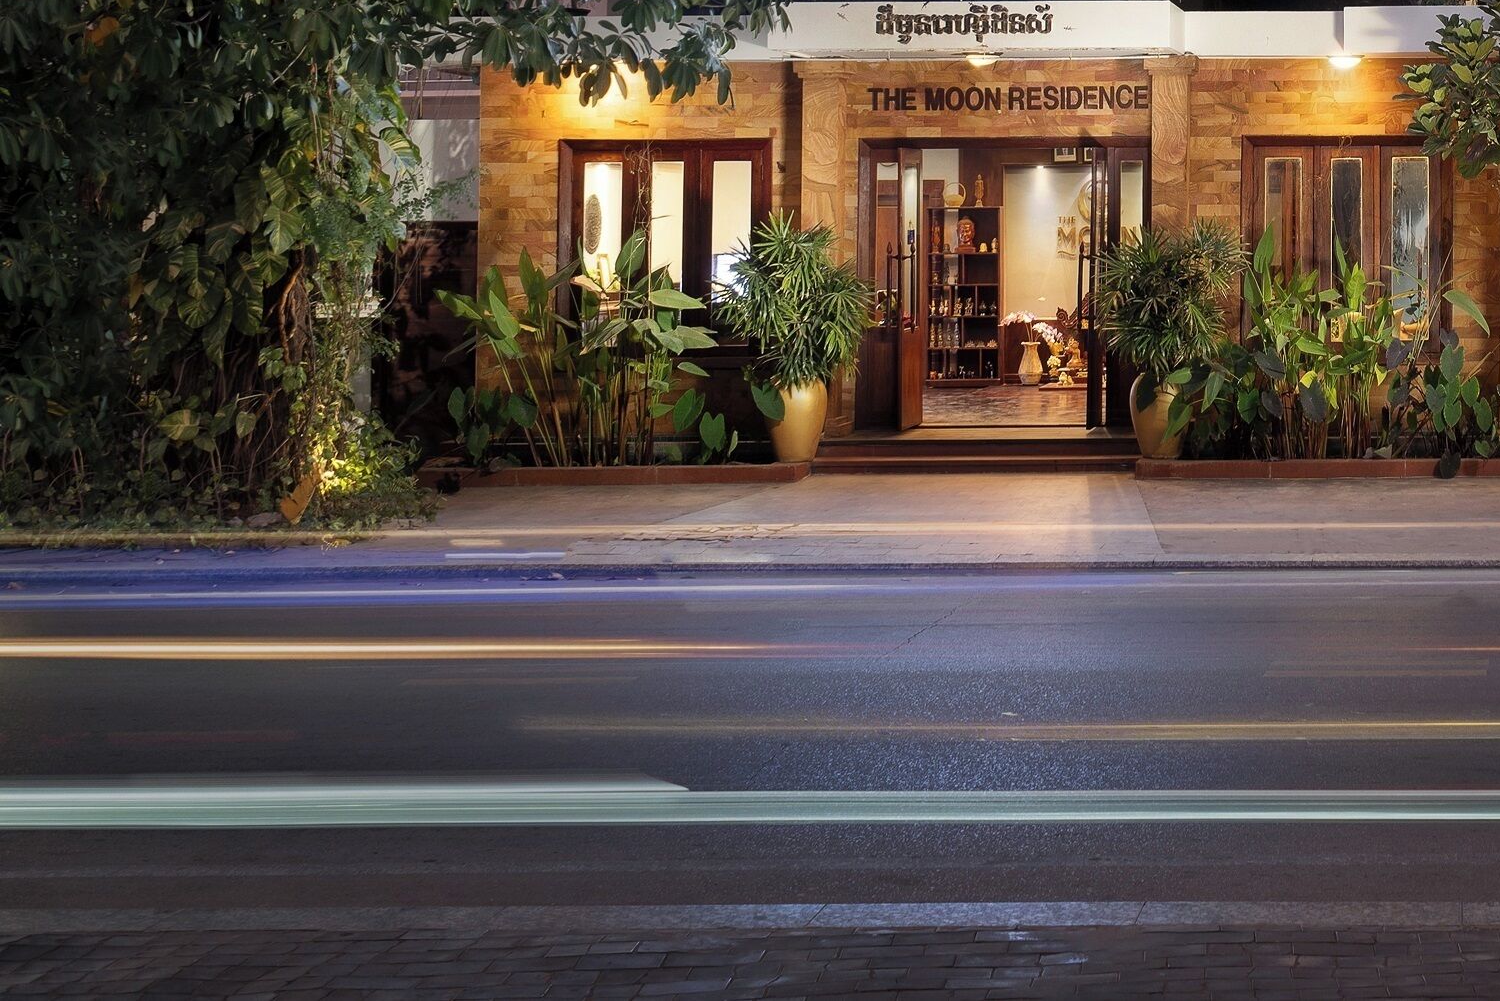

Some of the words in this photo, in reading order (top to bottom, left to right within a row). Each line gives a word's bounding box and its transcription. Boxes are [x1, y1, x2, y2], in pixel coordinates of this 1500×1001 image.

[867, 87, 917, 111] THE
[925, 86, 1000, 111] MOON
[1008, 84, 1148, 110] RESIDENCE
